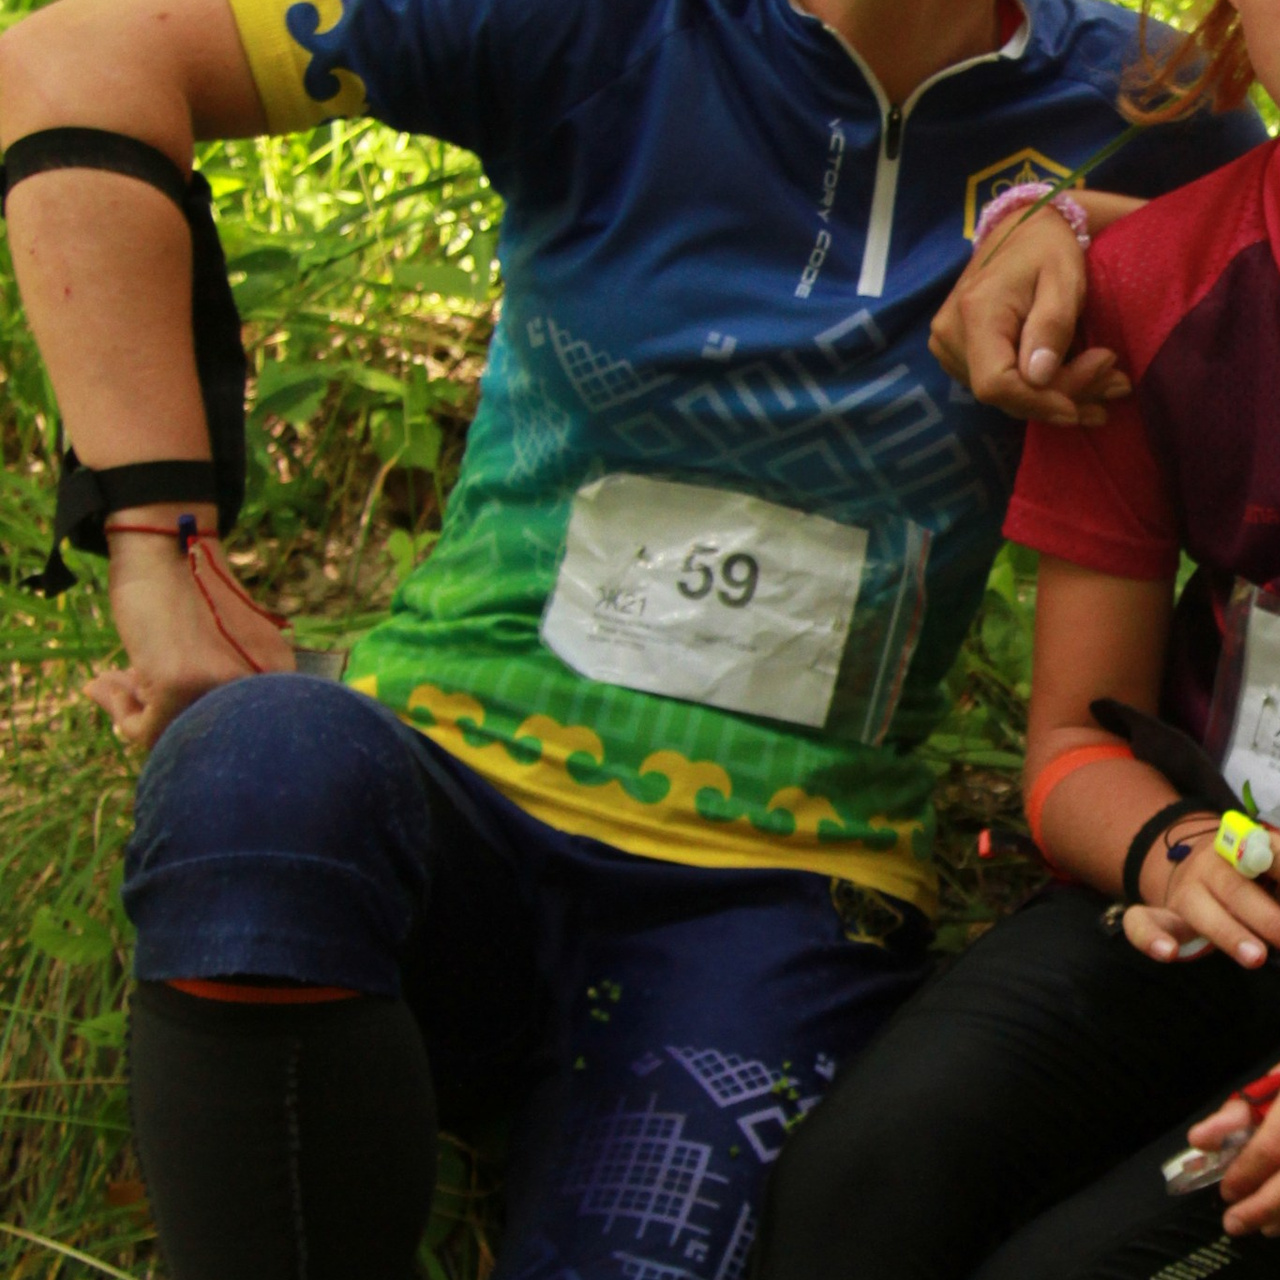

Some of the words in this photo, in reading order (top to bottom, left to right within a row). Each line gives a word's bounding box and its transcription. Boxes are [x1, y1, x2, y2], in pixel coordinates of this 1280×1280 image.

[817, 118, 847, 223] VCTORY
[794, 230, 831, 299] CODE
[676, 543, 760, 609] 59
